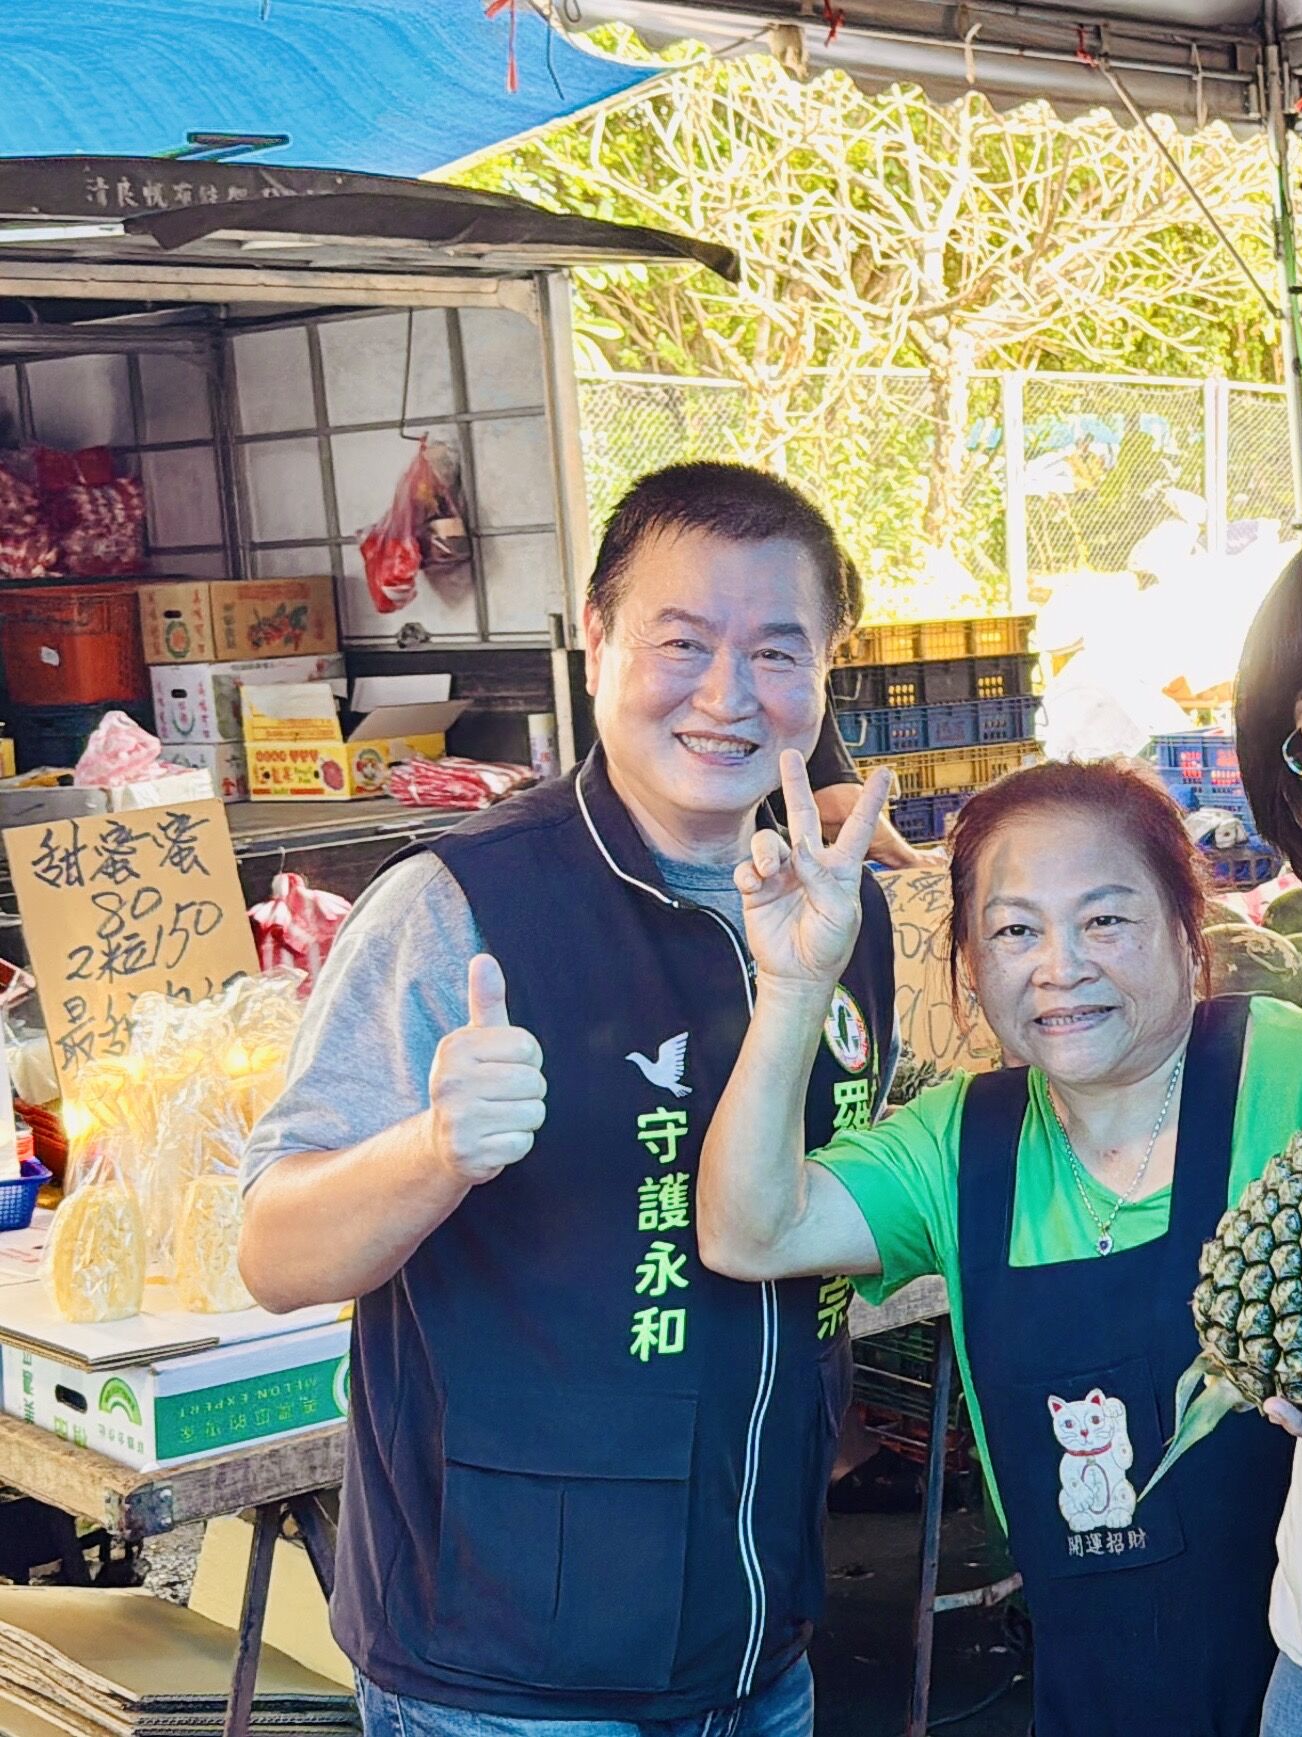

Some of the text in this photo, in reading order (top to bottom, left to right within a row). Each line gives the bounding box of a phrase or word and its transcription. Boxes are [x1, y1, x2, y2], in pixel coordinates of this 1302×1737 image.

[31, 812, 211, 888] 甜蜜蜜
[91, 886, 163, 939] 80
[629, 1106, 691, 1363] 守護永和
[1066, 1527, 1147, 1558] 開運招財
